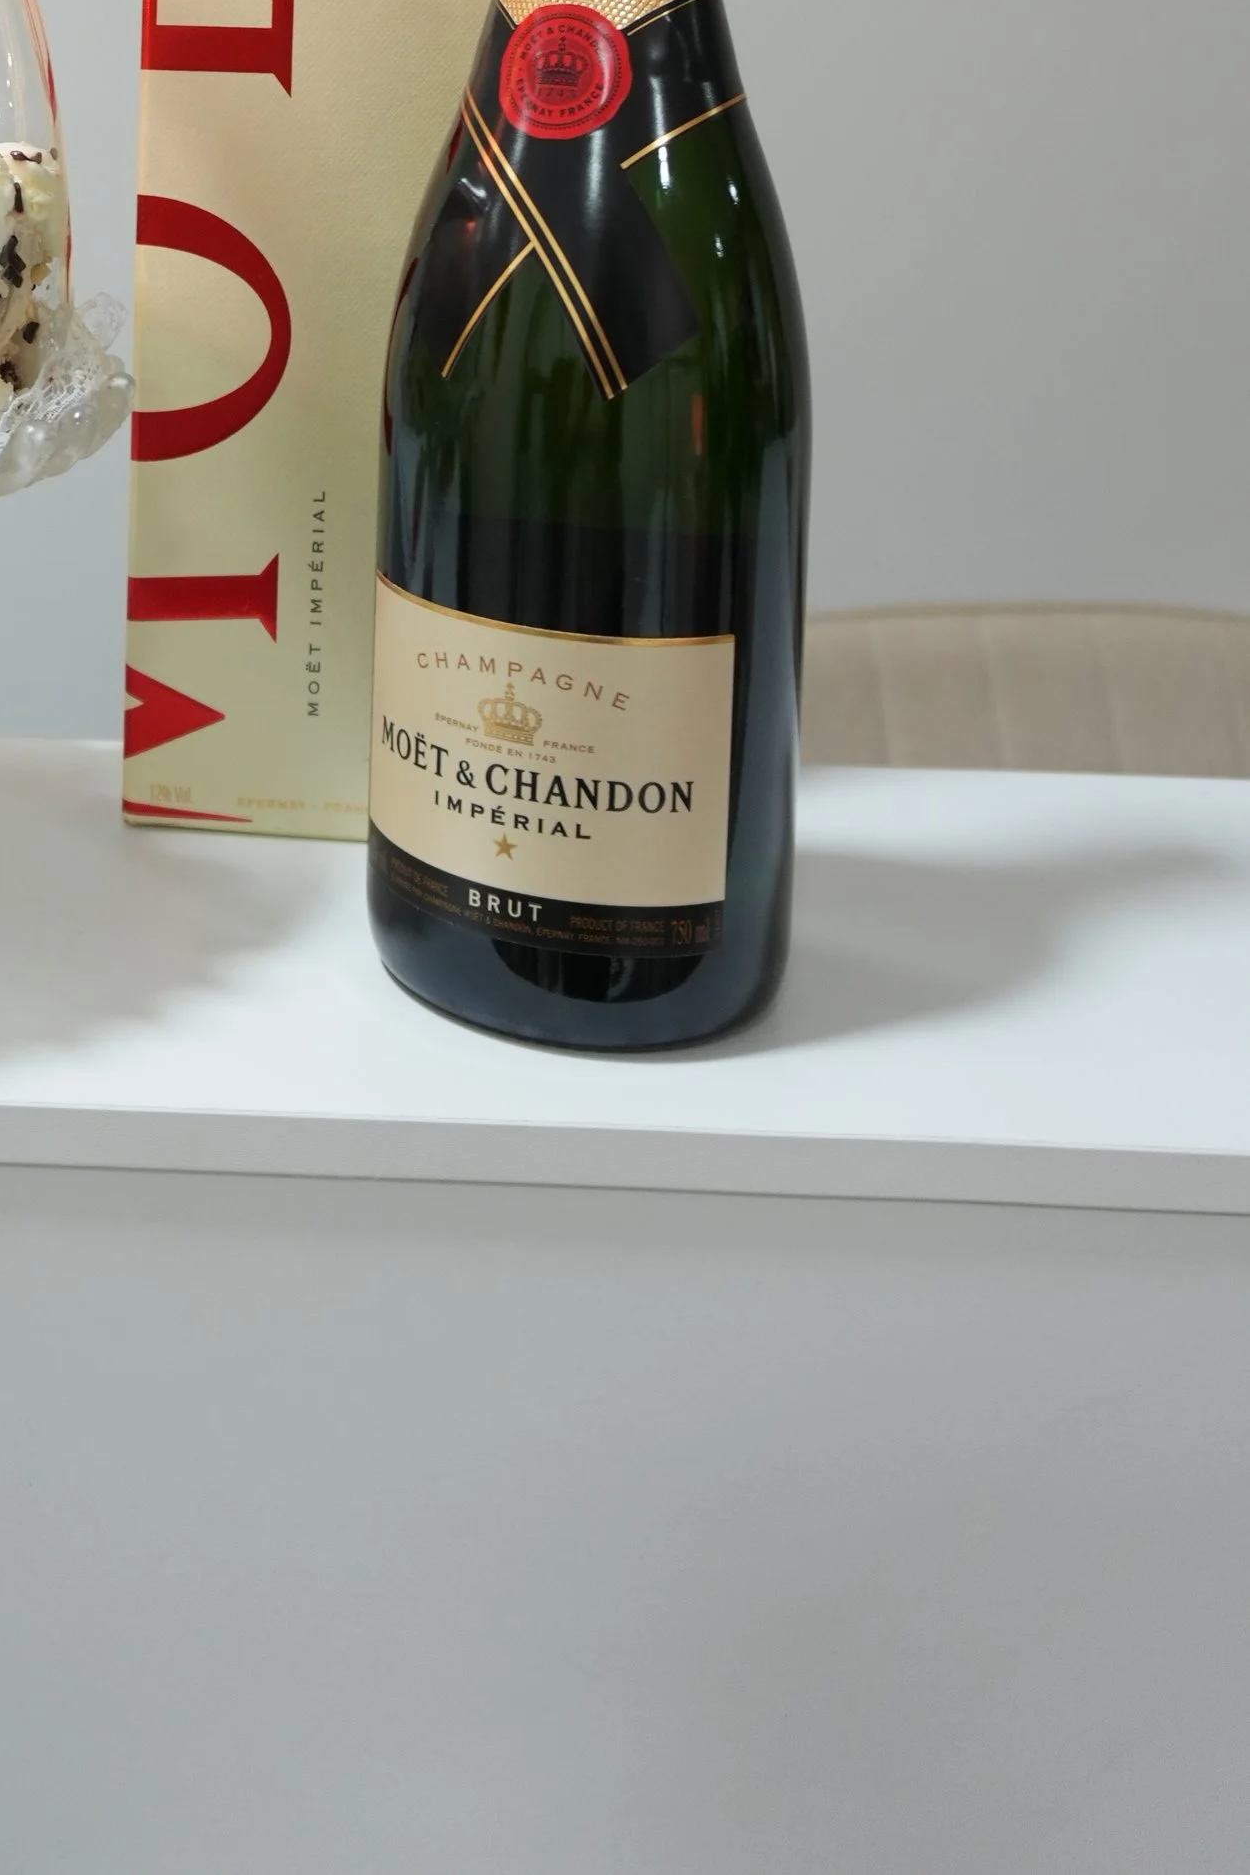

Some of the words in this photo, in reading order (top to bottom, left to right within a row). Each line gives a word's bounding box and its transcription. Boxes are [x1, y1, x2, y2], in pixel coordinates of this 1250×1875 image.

[307, 490, 327, 627] IMPÉRIAL
[305, 643, 322, 717] MOËT
[417, 651, 631, 712] CHAMPAGNE
[381, 715, 450, 778] MOËT
[455, 759, 478, 789] &
[485, 763, 695, 815] CHANDON
[507, 747, 524, 758] EN
[528, 751, 557, 765] 1743
[543, 739, 596, 754] FRANCE
[434, 790, 593, 840] IMPÉRIAL
[468, 888, 543, 923] BRUT
